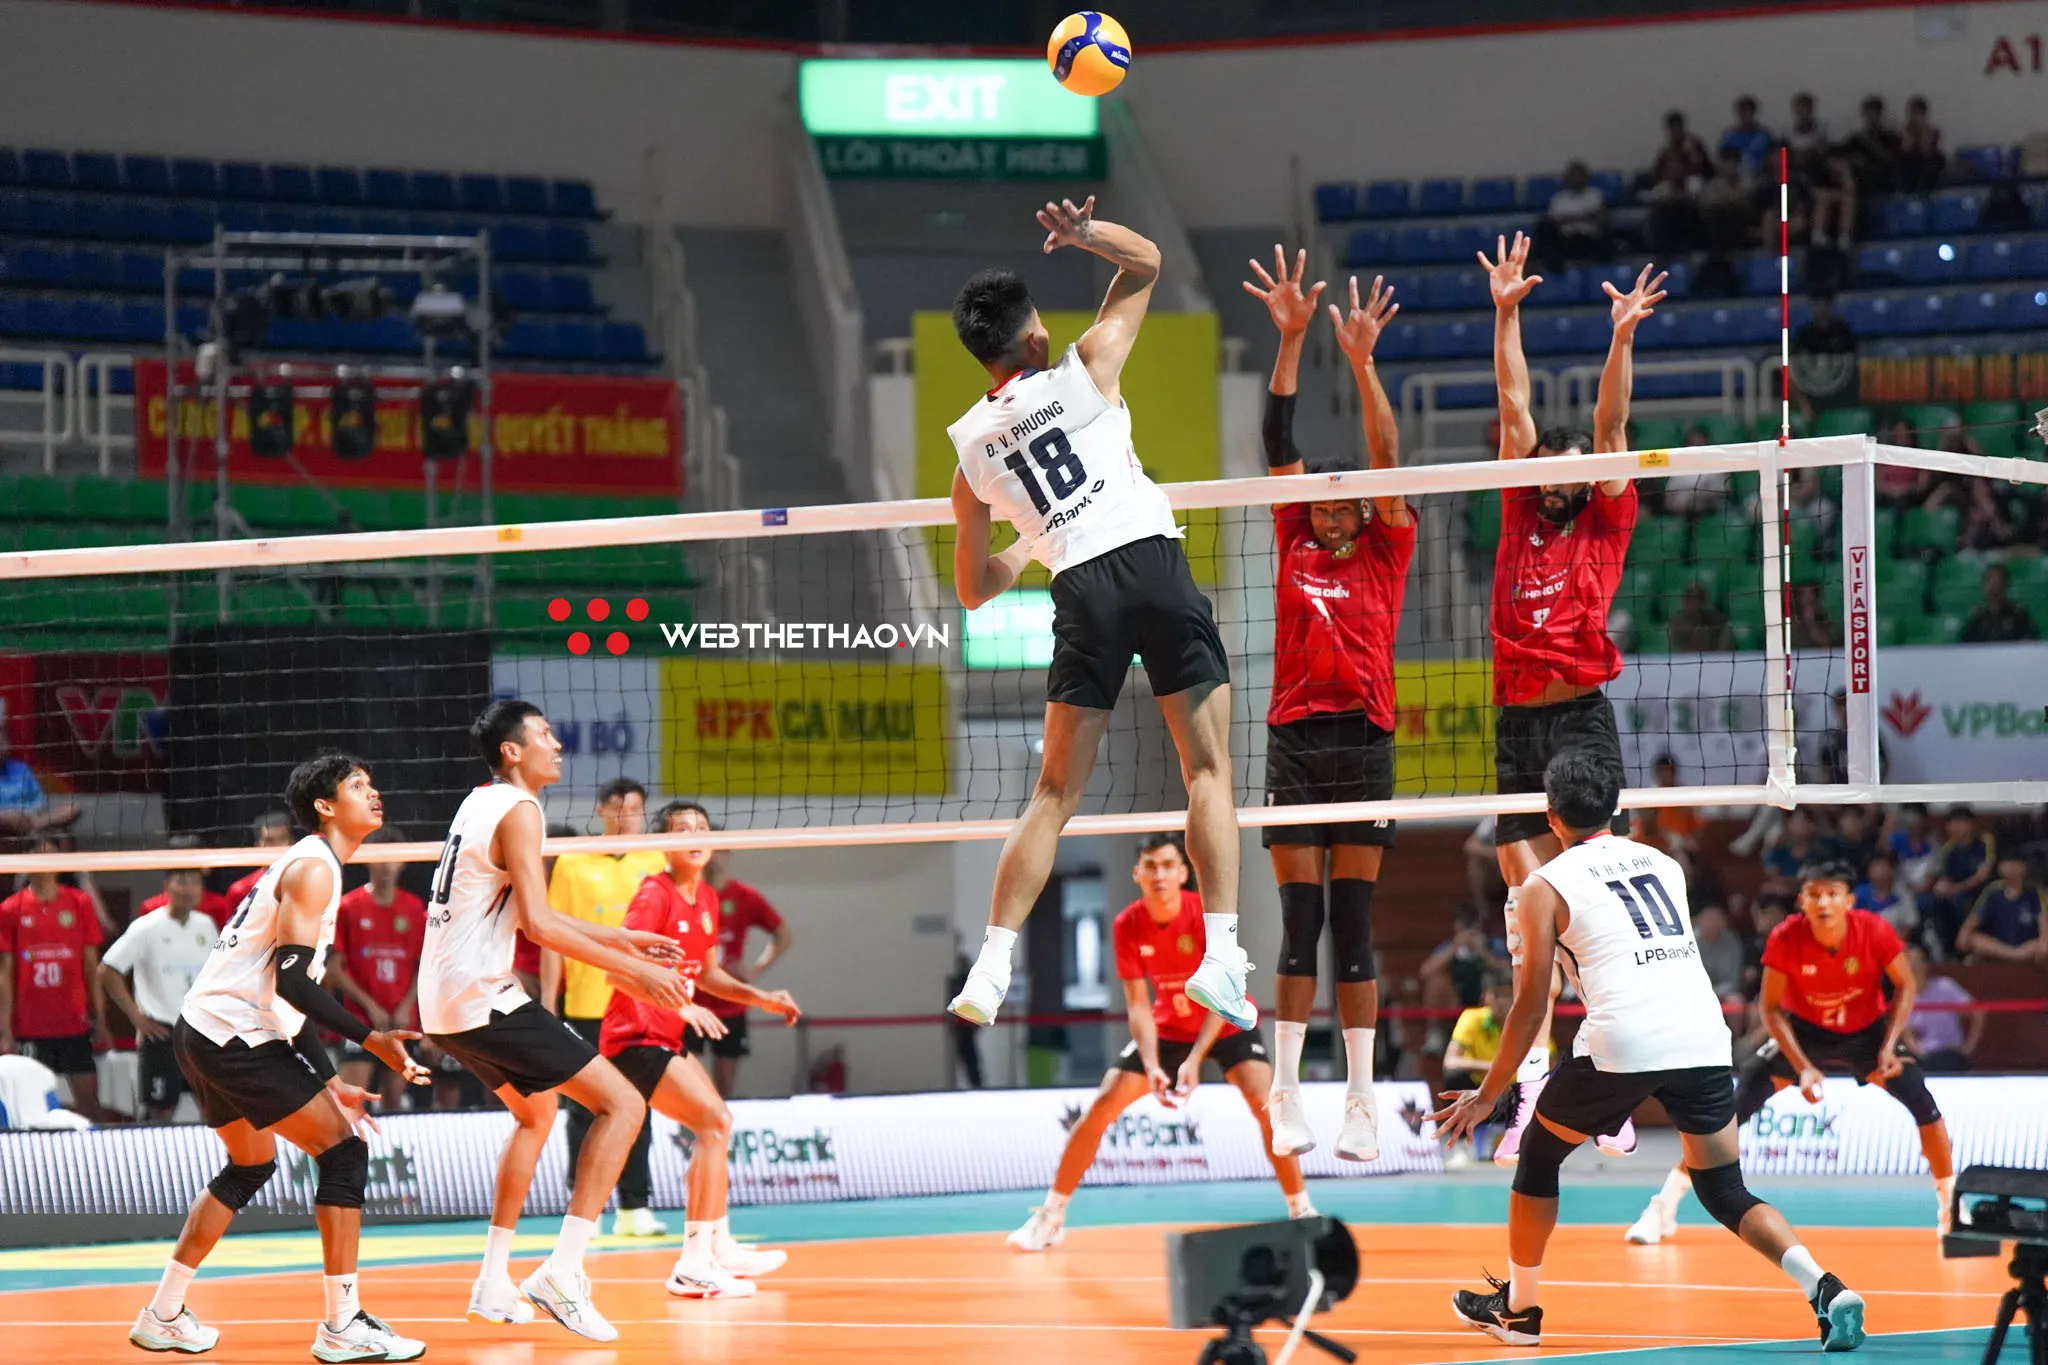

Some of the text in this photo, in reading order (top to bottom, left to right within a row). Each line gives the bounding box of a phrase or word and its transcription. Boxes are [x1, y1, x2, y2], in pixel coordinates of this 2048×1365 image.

[1984, 34, 2045, 77] A1
[885, 75, 1006, 121] EXIT
[985, 400, 1065, 458] Đ. V. PHƯƠNG
[1004, 427, 1087, 517] 18
[1035, 495, 1093, 539] PBank
[1851, 552, 1868, 691] VIFASPORT
[695, 699, 772, 740] NPK
[1941, 701, 2048, 738] VPBa
[1632, 857, 1653, 870] PHI
[1605, 873, 1685, 940] 10
[33, 961, 61, 988] 20
[1635, 944, 1692, 966] LPBank
[1756, 1104, 1838, 1137] Bank
